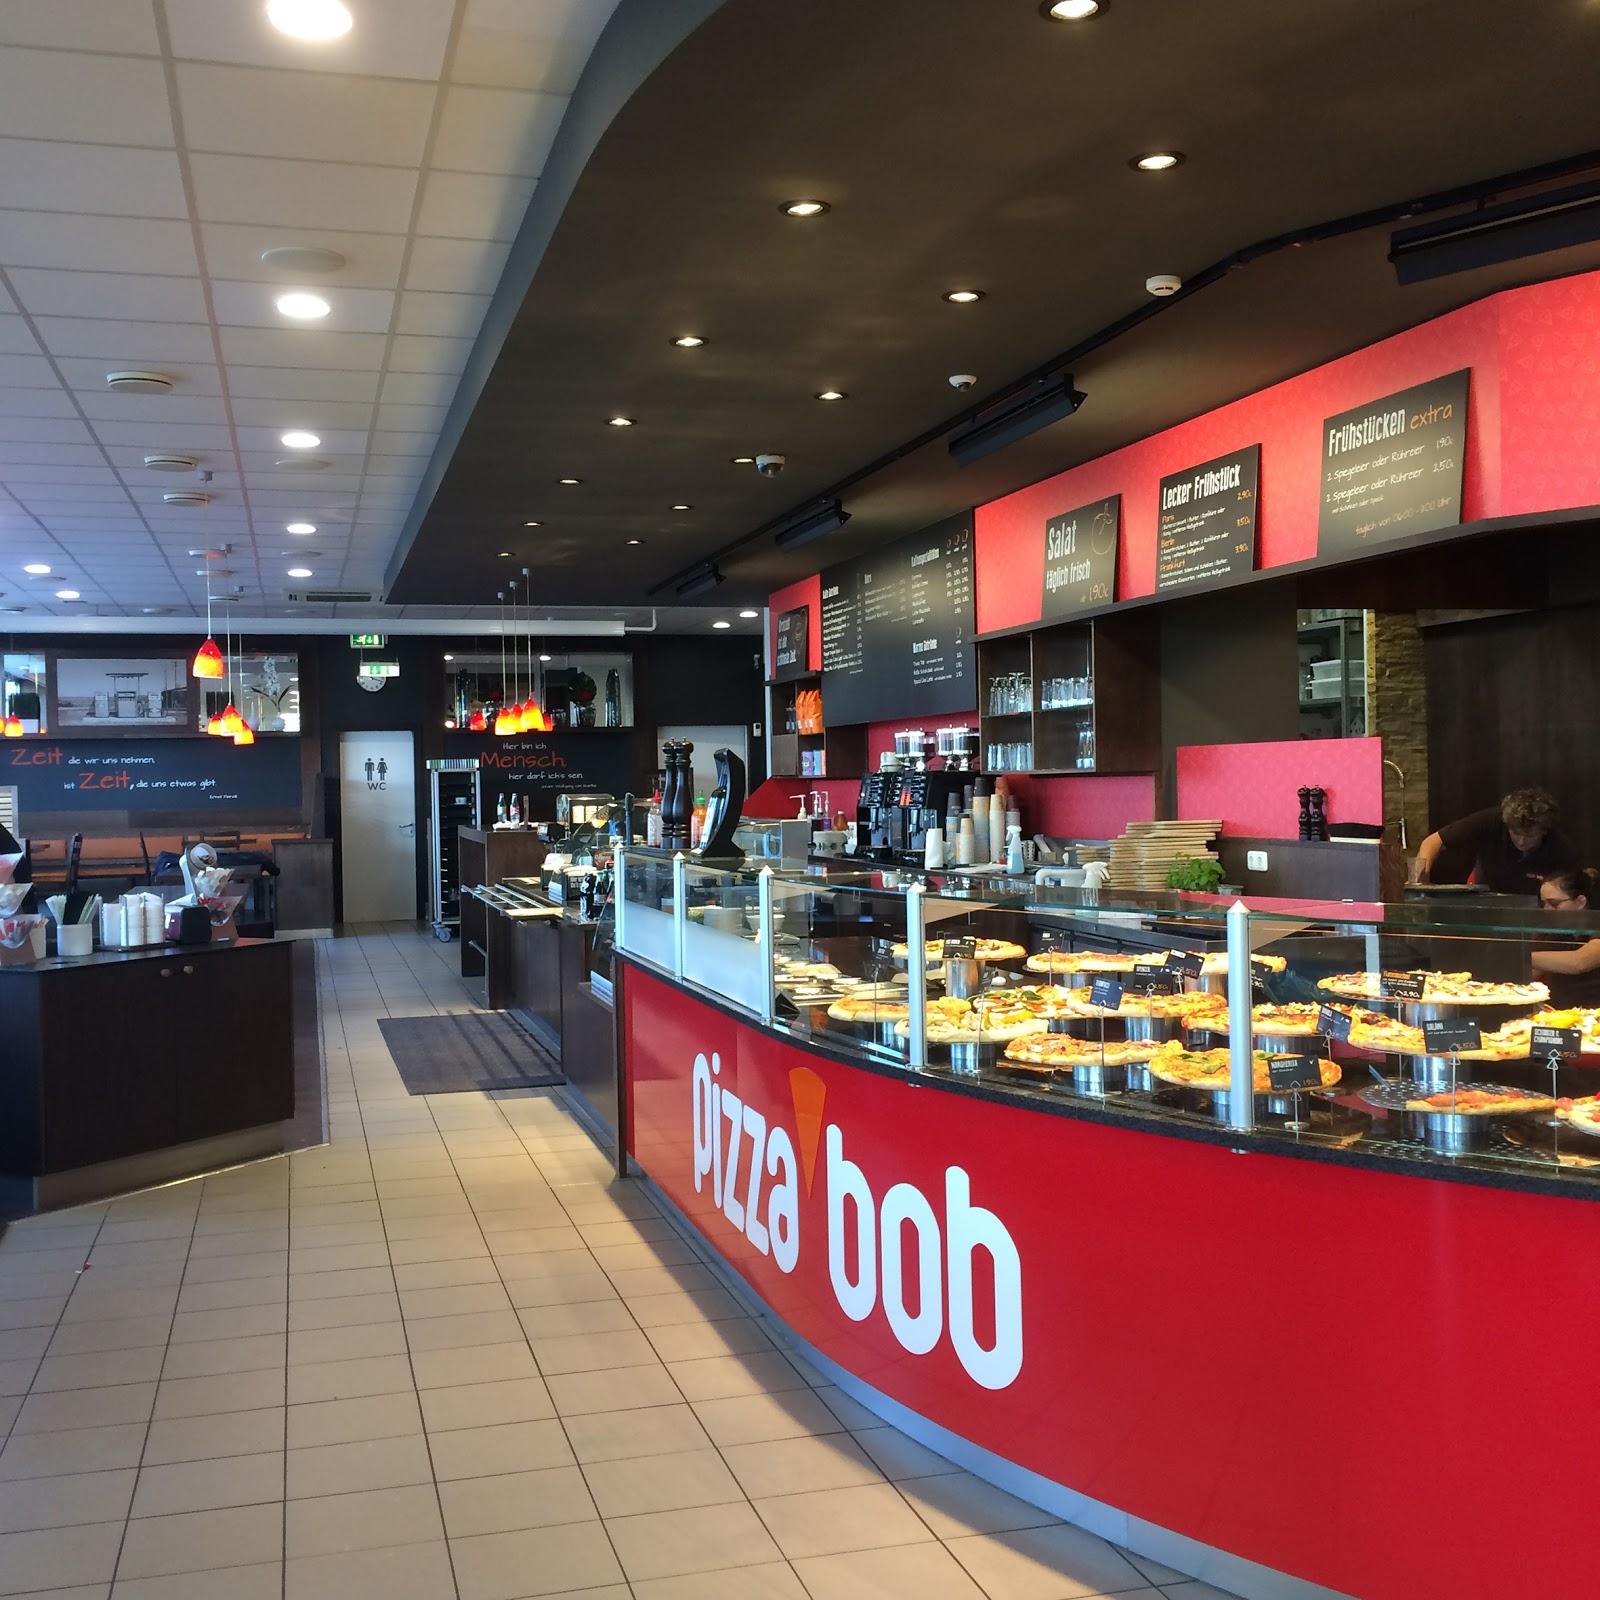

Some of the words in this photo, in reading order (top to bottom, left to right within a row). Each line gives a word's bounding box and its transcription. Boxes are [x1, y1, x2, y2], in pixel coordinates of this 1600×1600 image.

[1328, 409, 1406, 457] Frühstücken
[1410, 404, 1453, 430] extra
[1327, 472, 1333, 482] 2
[1372, 454, 1389, 469] oder
[1163, 482, 1192, 511] Lecker
[1194, 464, 1241, 500] Frühstück
[1370, 477, 1388, 490] oder
[1355, 520, 1377, 538] täglich
[1378, 516, 1391, 527] von
[1048, 520, 1077, 561] Salat
[1046, 565, 1069, 593] täglich
[1069, 559, 1091, 584] frisch
[502, 742, 519, 750] Hier
[521, 742, 533, 750] bin
[535, 742, 547, 750] ich
[10, 747, 63, 765] Zeit
[68, 756, 81, 765] die
[102, 757, 118, 765] uns
[480, 751, 567, 769] Mensch
[508, 772, 524, 780] hier
[526, 771, 546, 780] darf
[64, 782, 76, 790] ist
[136, 780, 149, 788] die
[151, 780, 167, 788] uns
[169, 780, 197, 788] etwas
[367, 782, 387, 791] WC
